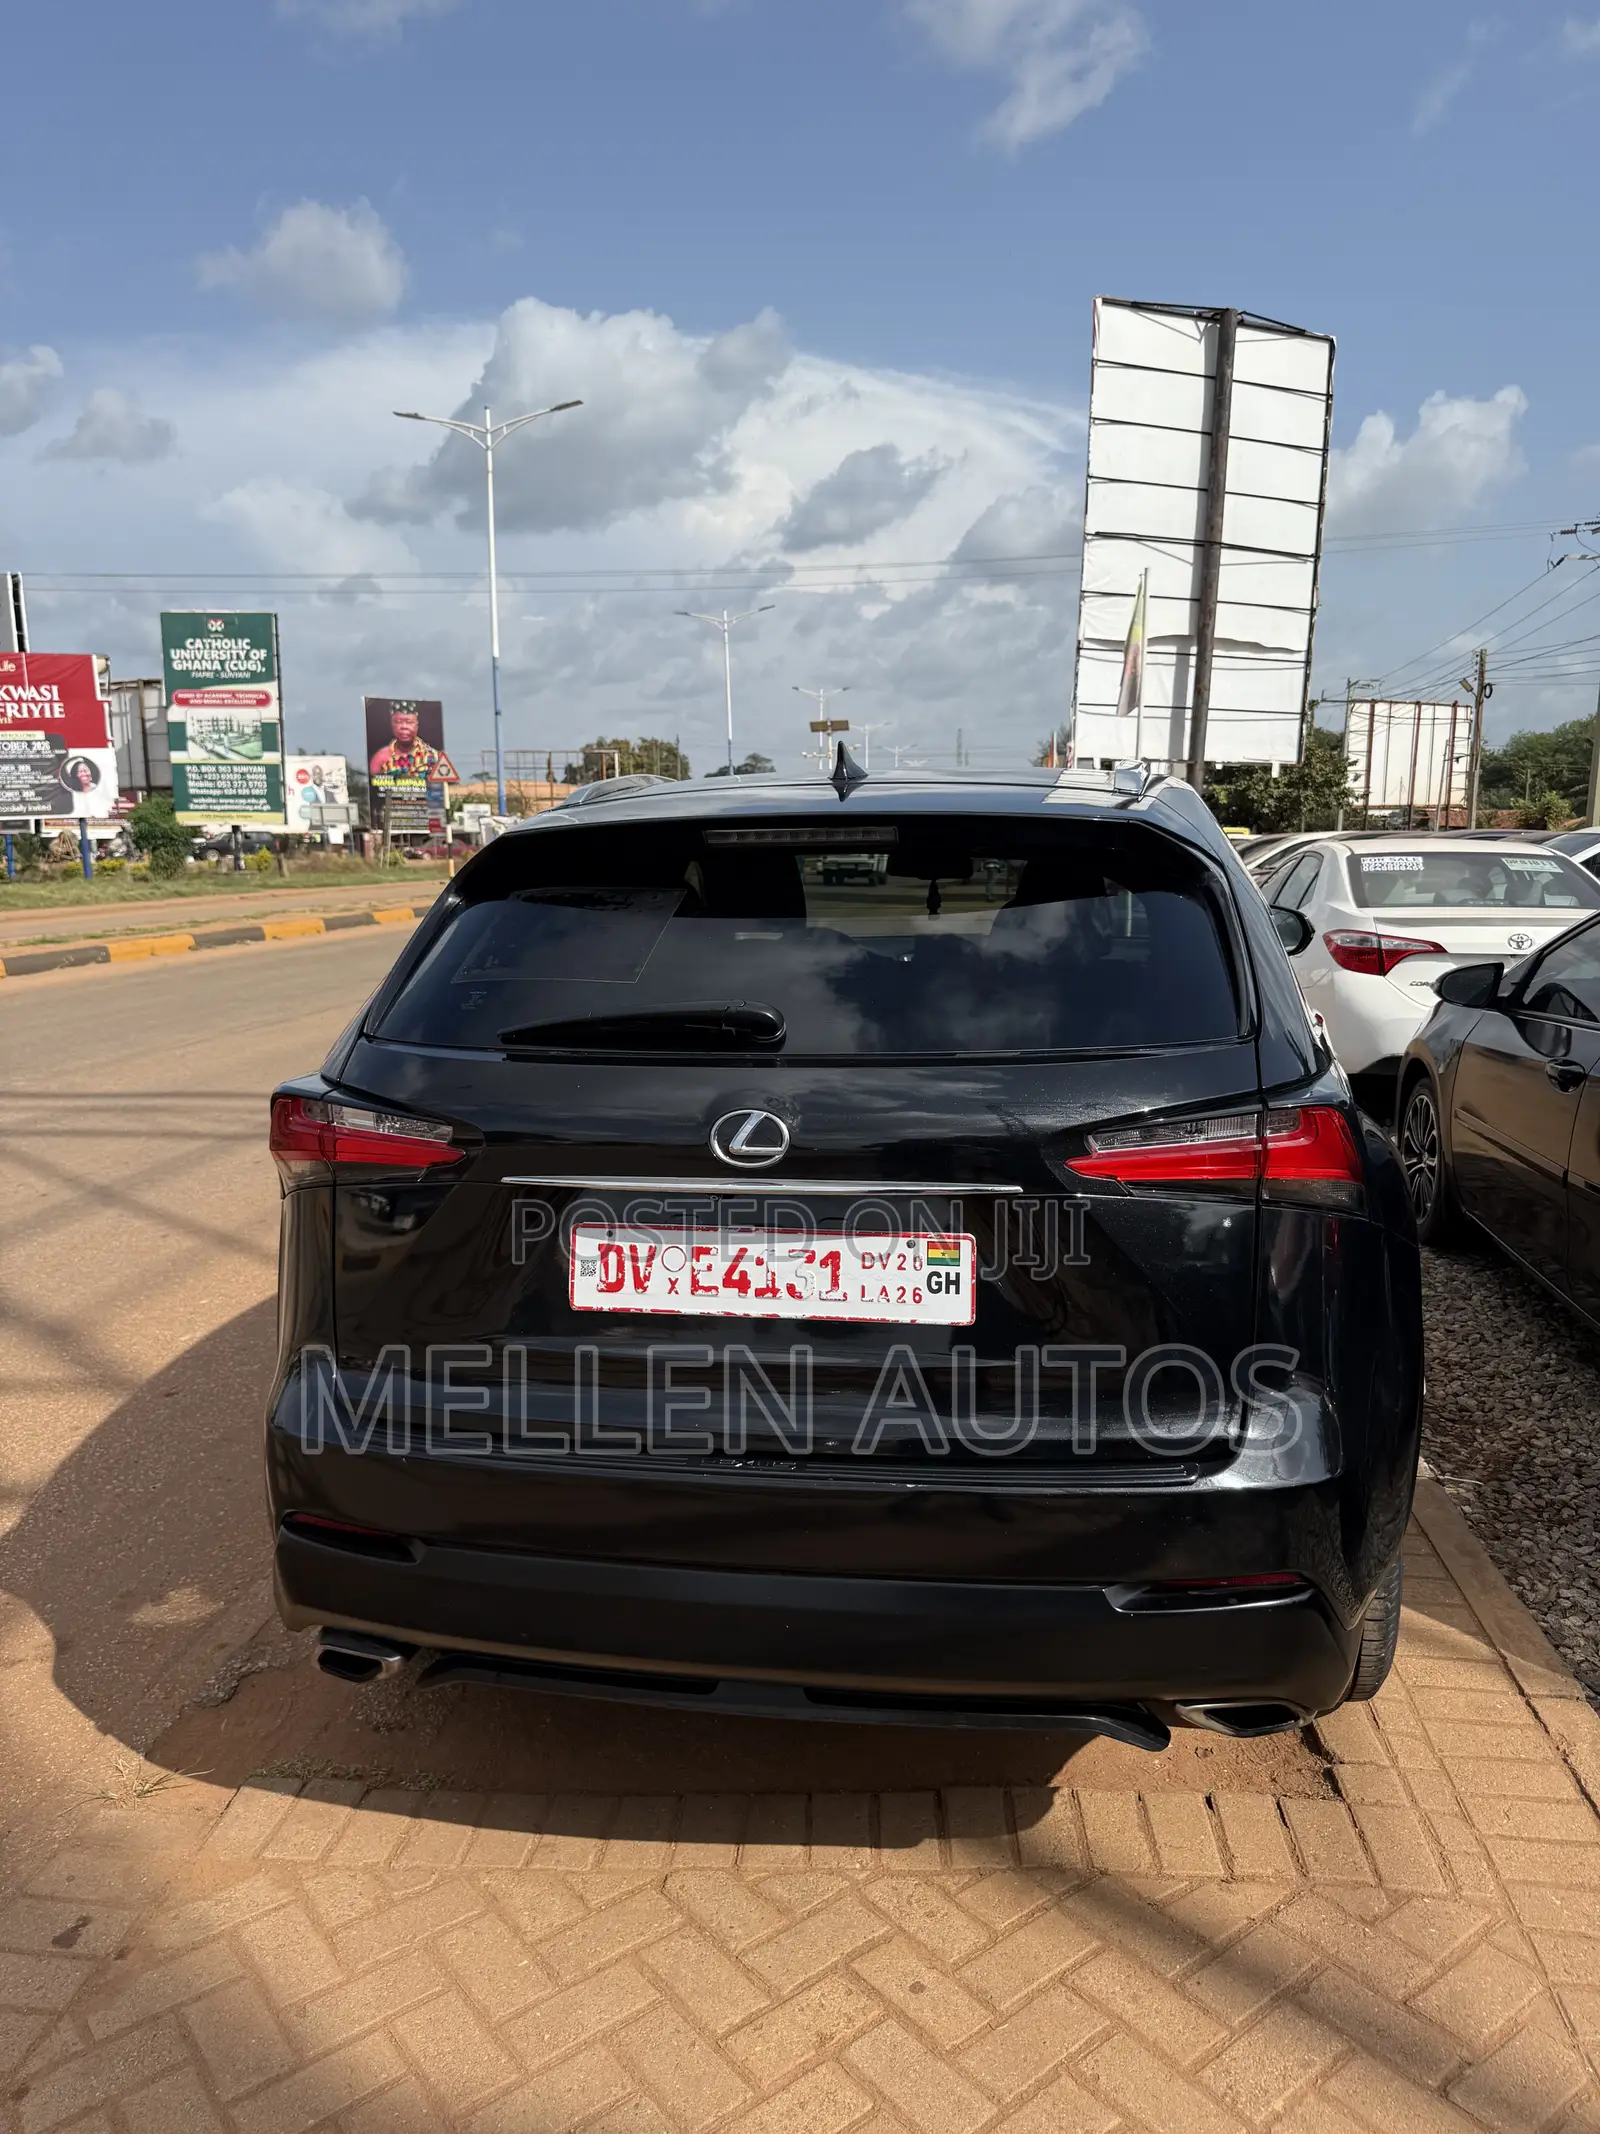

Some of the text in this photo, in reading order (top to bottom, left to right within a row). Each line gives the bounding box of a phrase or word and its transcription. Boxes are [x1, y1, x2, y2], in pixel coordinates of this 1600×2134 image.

[185, 638, 251, 650] CATHOLIC
[170, 648, 268, 660] UNIVERSITY OF
[172, 660, 222, 671] GHANA
[0, 684, 60, 701] KWASI
[201, 765, 217, 773] BOX
[232, 765, 266, 773] SUNYANI
[597, 1244, 657, 1293] DV
[926, 1271, 960, 1294] GH
